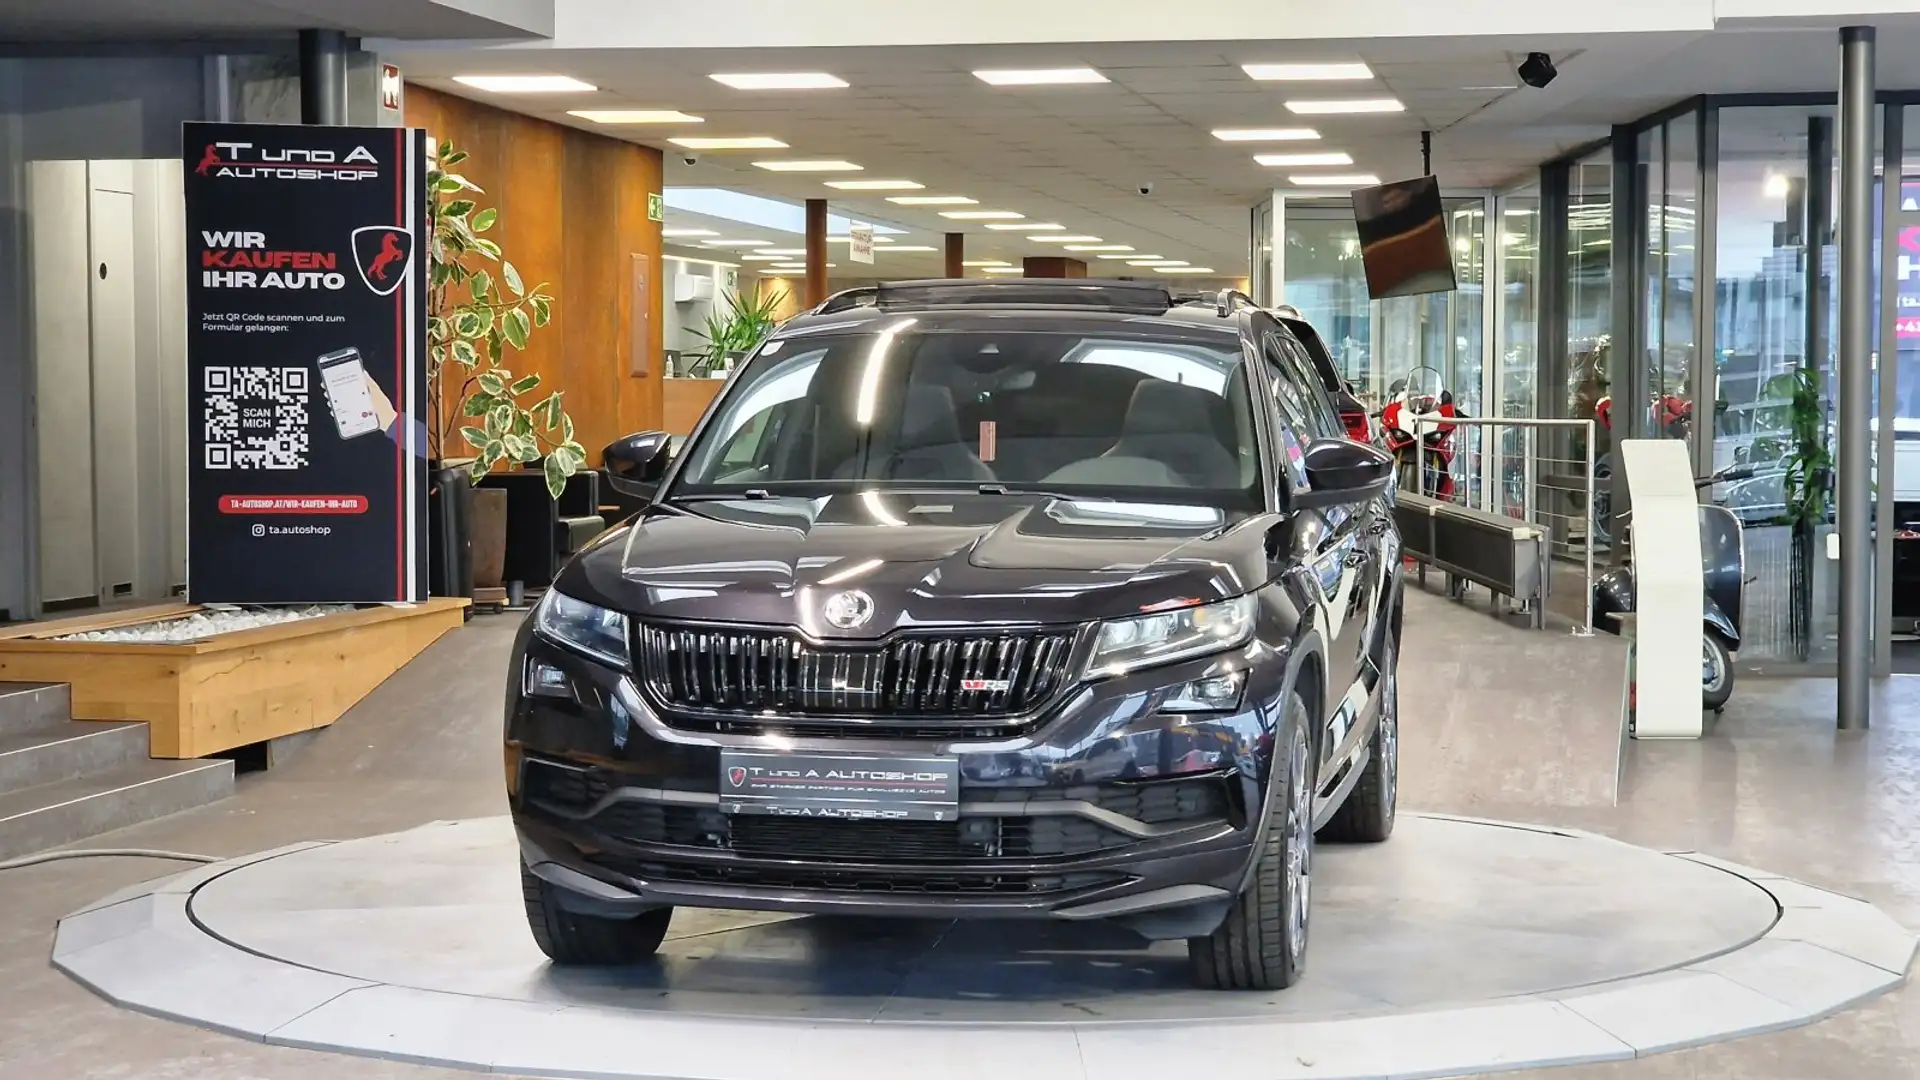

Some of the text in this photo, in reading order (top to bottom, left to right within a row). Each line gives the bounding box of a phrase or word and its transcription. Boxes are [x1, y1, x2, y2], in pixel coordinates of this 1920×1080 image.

[216, 142, 252, 160] T
[343, 146, 378, 163] A
[216, 167, 378, 180] AUTOSHOP
[202, 231, 265, 248] WIR
[202, 250, 336, 269] KAUFEN
[203, 271, 346, 290] IHR AUTO
[202, 312, 345, 323] Jetzt QR Code scannen und zum
[203, 323, 289, 332] Formular gelangen:
[243, 408, 271, 418] SCAN
[243, 419, 271, 429] MICH
[269, 525, 331, 536] ta.autoshop
[749, 767, 764, 776] T
[805, 769, 820, 778] A
[826, 770, 949, 781] AUTOSHOP
[818, 808, 909, 819] AUTOSHOP
